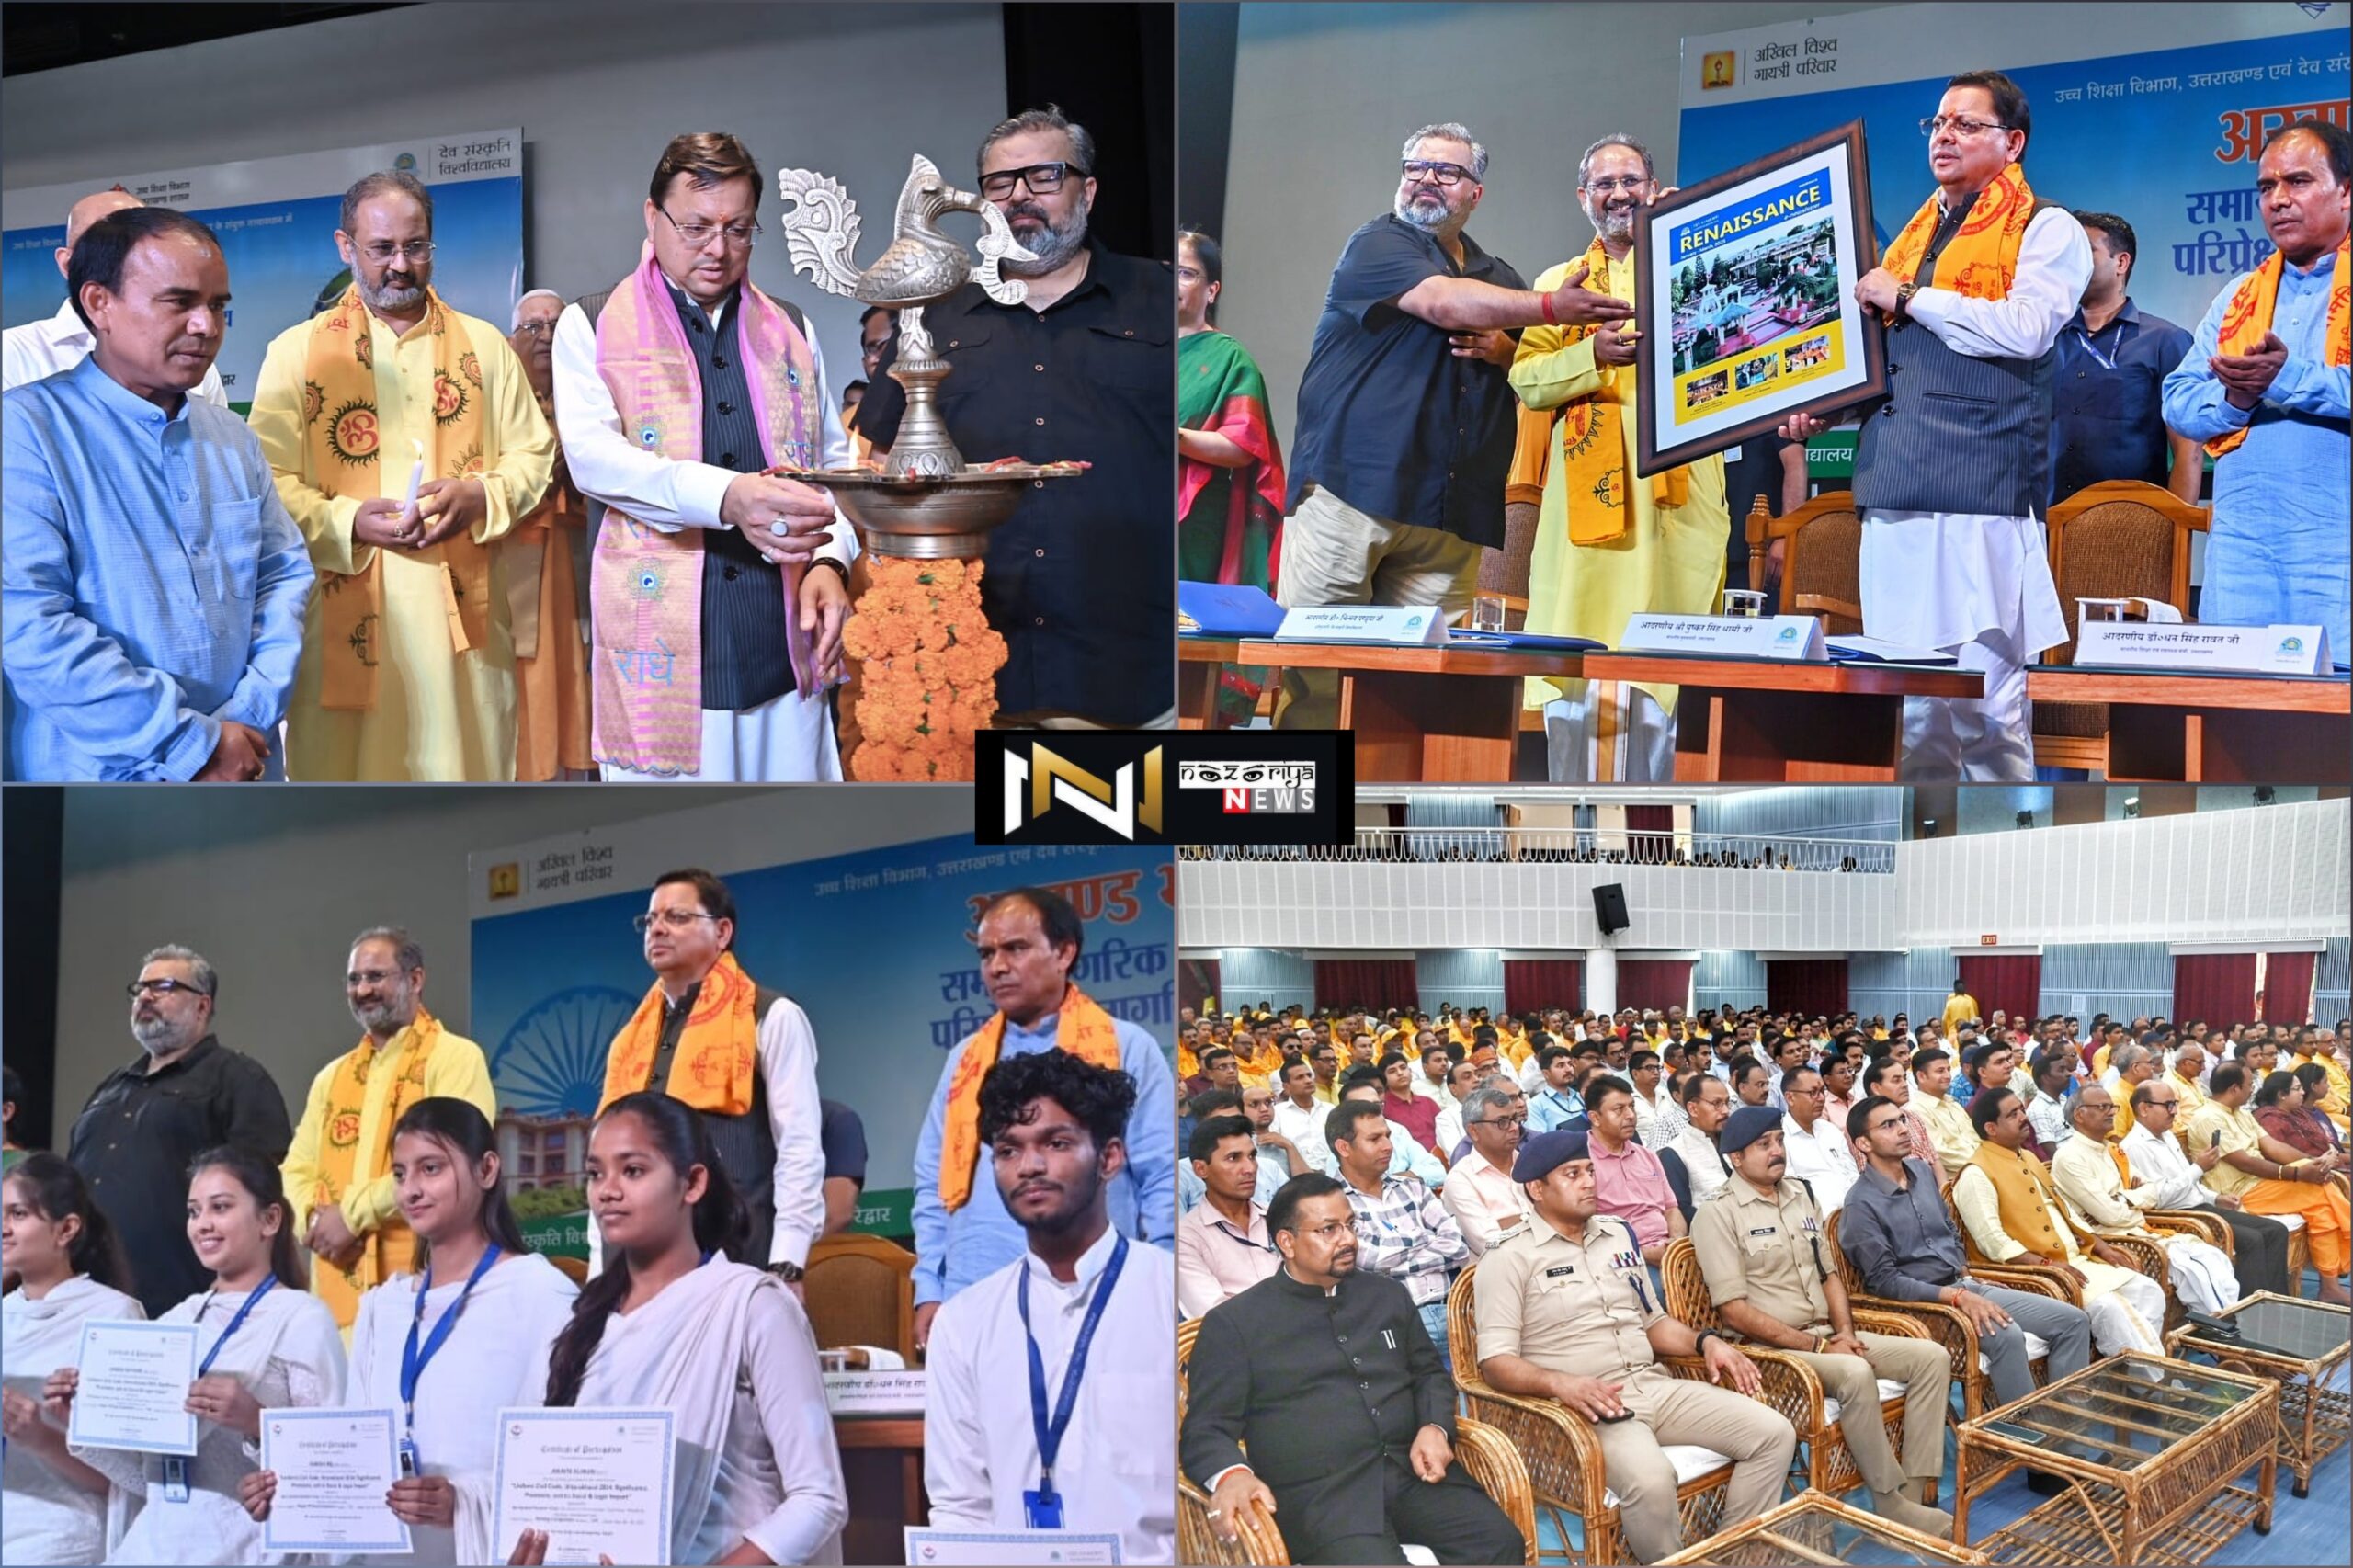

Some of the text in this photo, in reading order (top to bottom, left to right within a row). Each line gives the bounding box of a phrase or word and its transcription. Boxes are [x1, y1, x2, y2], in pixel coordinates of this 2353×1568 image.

[1754, 37, 1837, 62] अखिल विश्व
[1754, 57, 1837, 81] गायत्री परिवार
[2055, 89, 2081, 103] उच्च
[2087, 82, 2124, 99] शिक्षा
[2130, 77, 2182, 95] विभाग,
[2188, 67, 2263, 88] उत्तराखण्ड
[2268, 60, 2292, 80] एवं
[2298, 57, 2320, 75] देव
[438, 137, 510, 158] देव संस्कृति
[439, 157, 511, 175] विश्वविद्यालय
[1680, 185, 1821, 253] RENAISSANCE
[2186, 188, 2261, 225] समा
[2102, 631, 2144, 641] आदरणीय
[2201, 634, 2224, 643] रावत
[2227, 633, 2240, 644] जी
[615, 637, 676, 687] राधे
